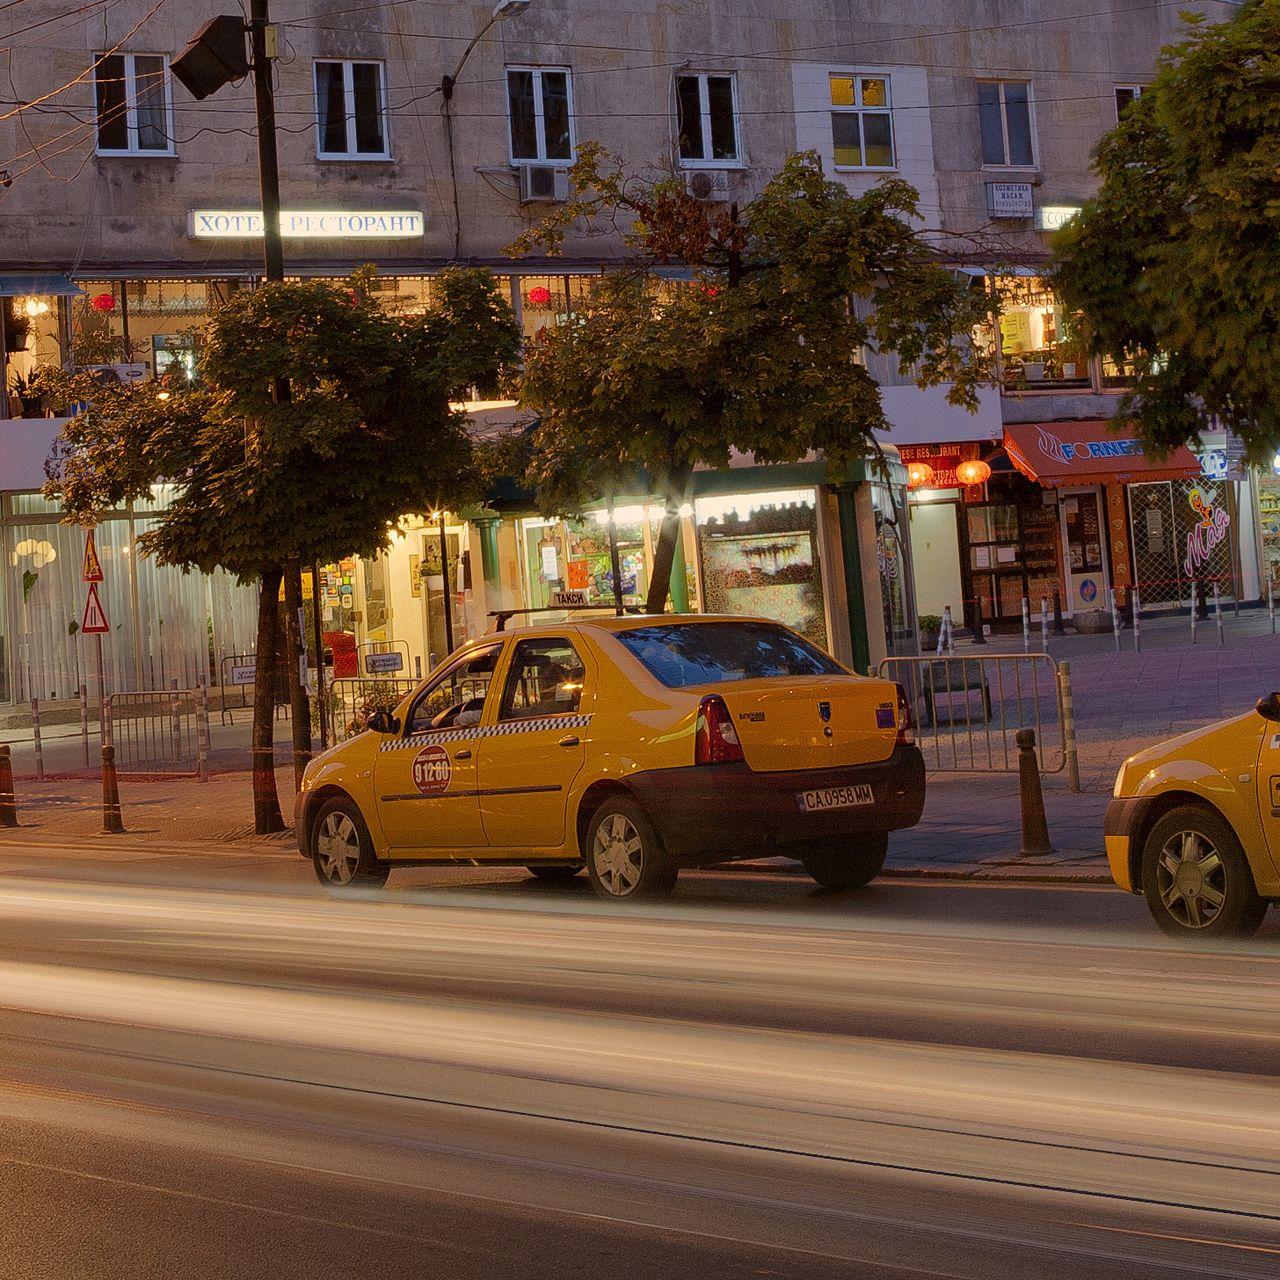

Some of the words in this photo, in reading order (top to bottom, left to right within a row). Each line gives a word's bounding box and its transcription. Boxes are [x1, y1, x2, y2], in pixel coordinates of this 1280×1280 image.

[199, 215, 266, 232] ХОТЕ
[290, 215, 420, 232] РЕСТОРАНТ
[556, 593, 584, 605] ТАКСИ
